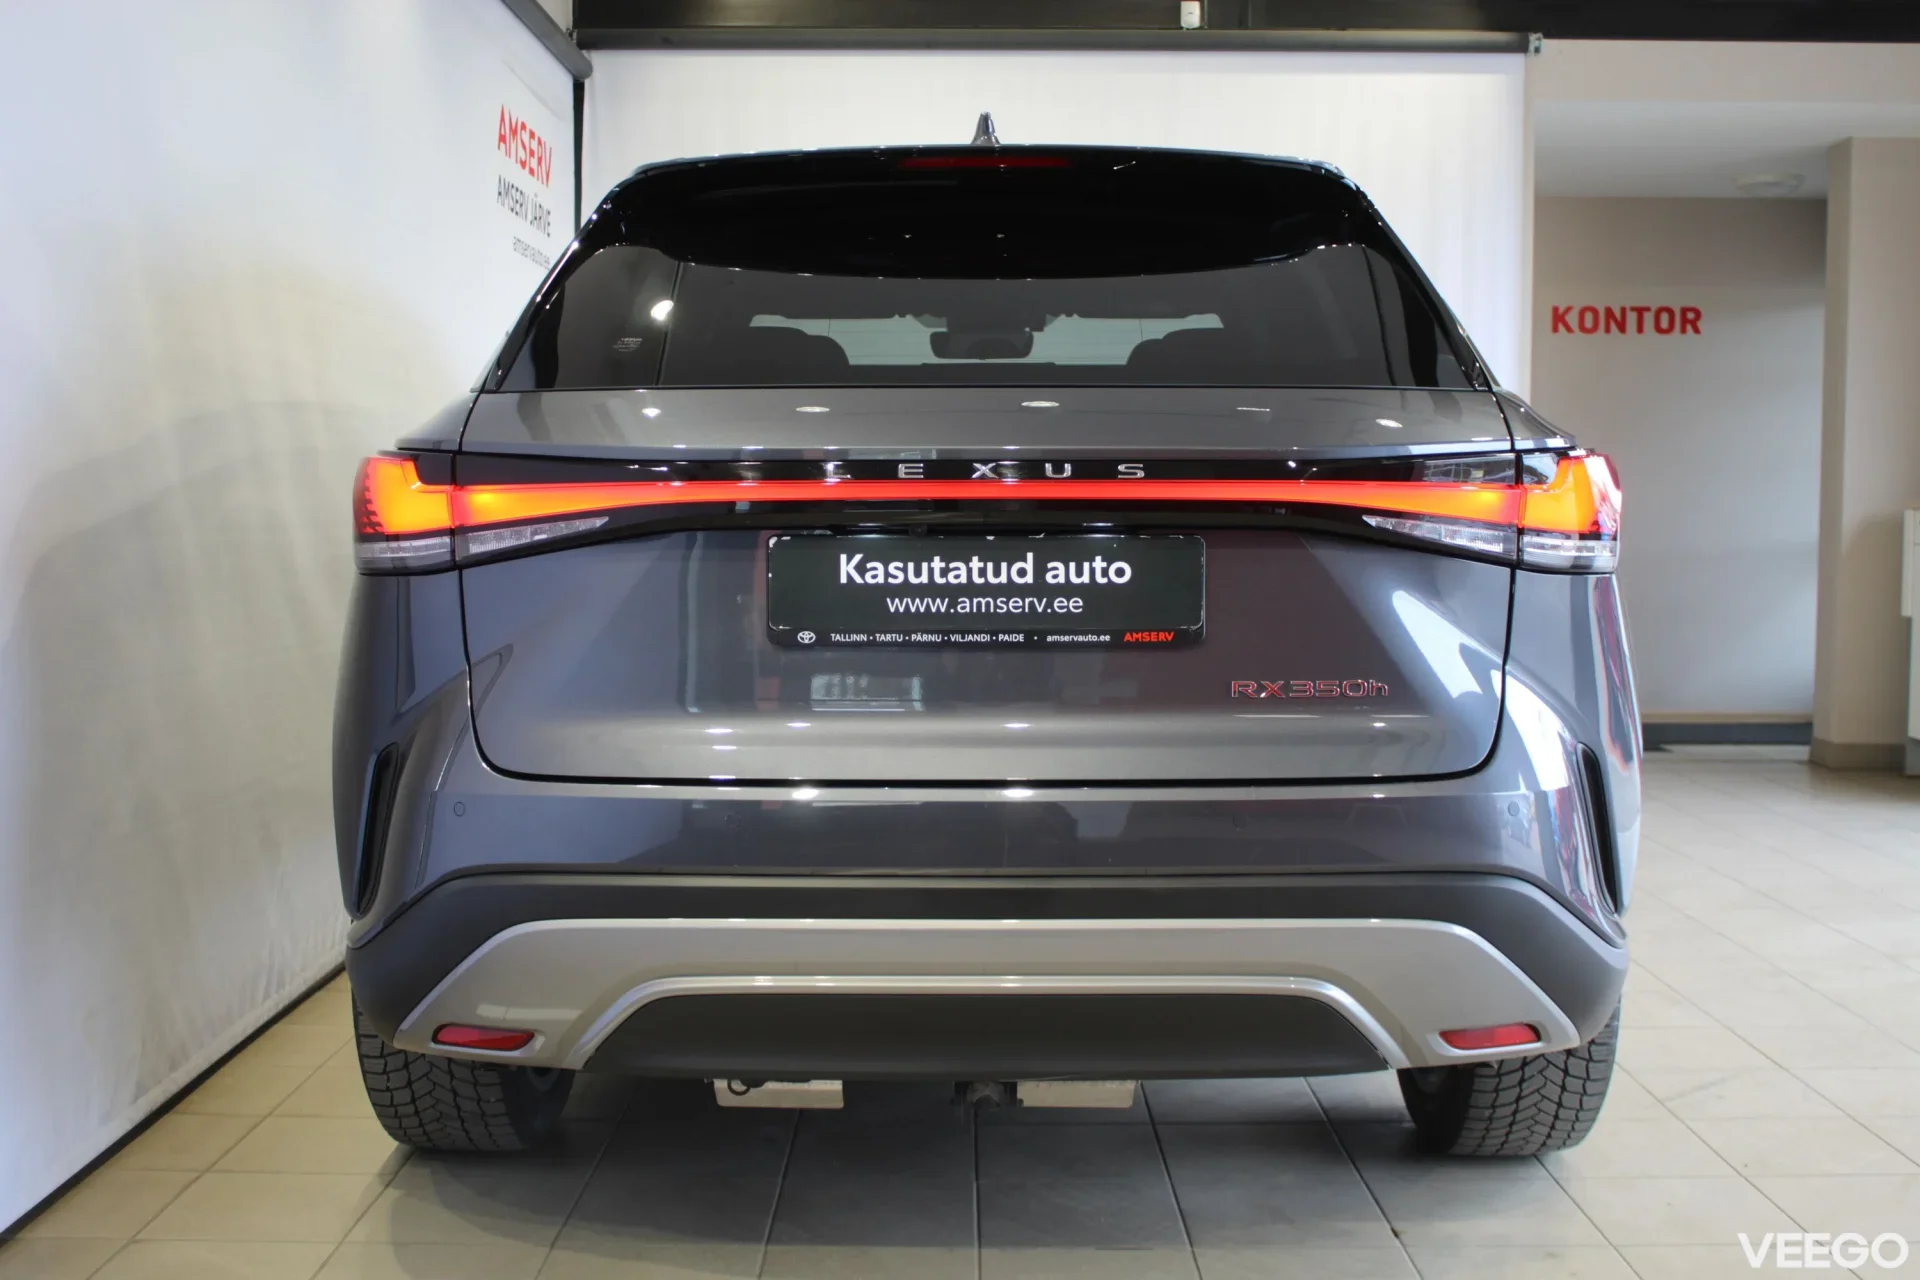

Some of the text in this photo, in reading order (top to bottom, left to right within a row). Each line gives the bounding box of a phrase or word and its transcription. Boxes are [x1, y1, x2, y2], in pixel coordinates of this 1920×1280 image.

[497, 103, 552, 188] AMSERV
[497, 174, 529, 224] AMSERV
[1551, 305, 1703, 335] KONTOR
[826, 462, 1146, 479] LEXUS
[839, 552, 1132, 585] Kasutatud auto
[886, 597, 1084, 614] www.amserv.ee
[830, 631, 1175, 643] TALLINN TARTU PÄRNU VILJANDI PAIDE amservauto.ee AMSERV
[1231, 679, 1389, 698] RX350h
